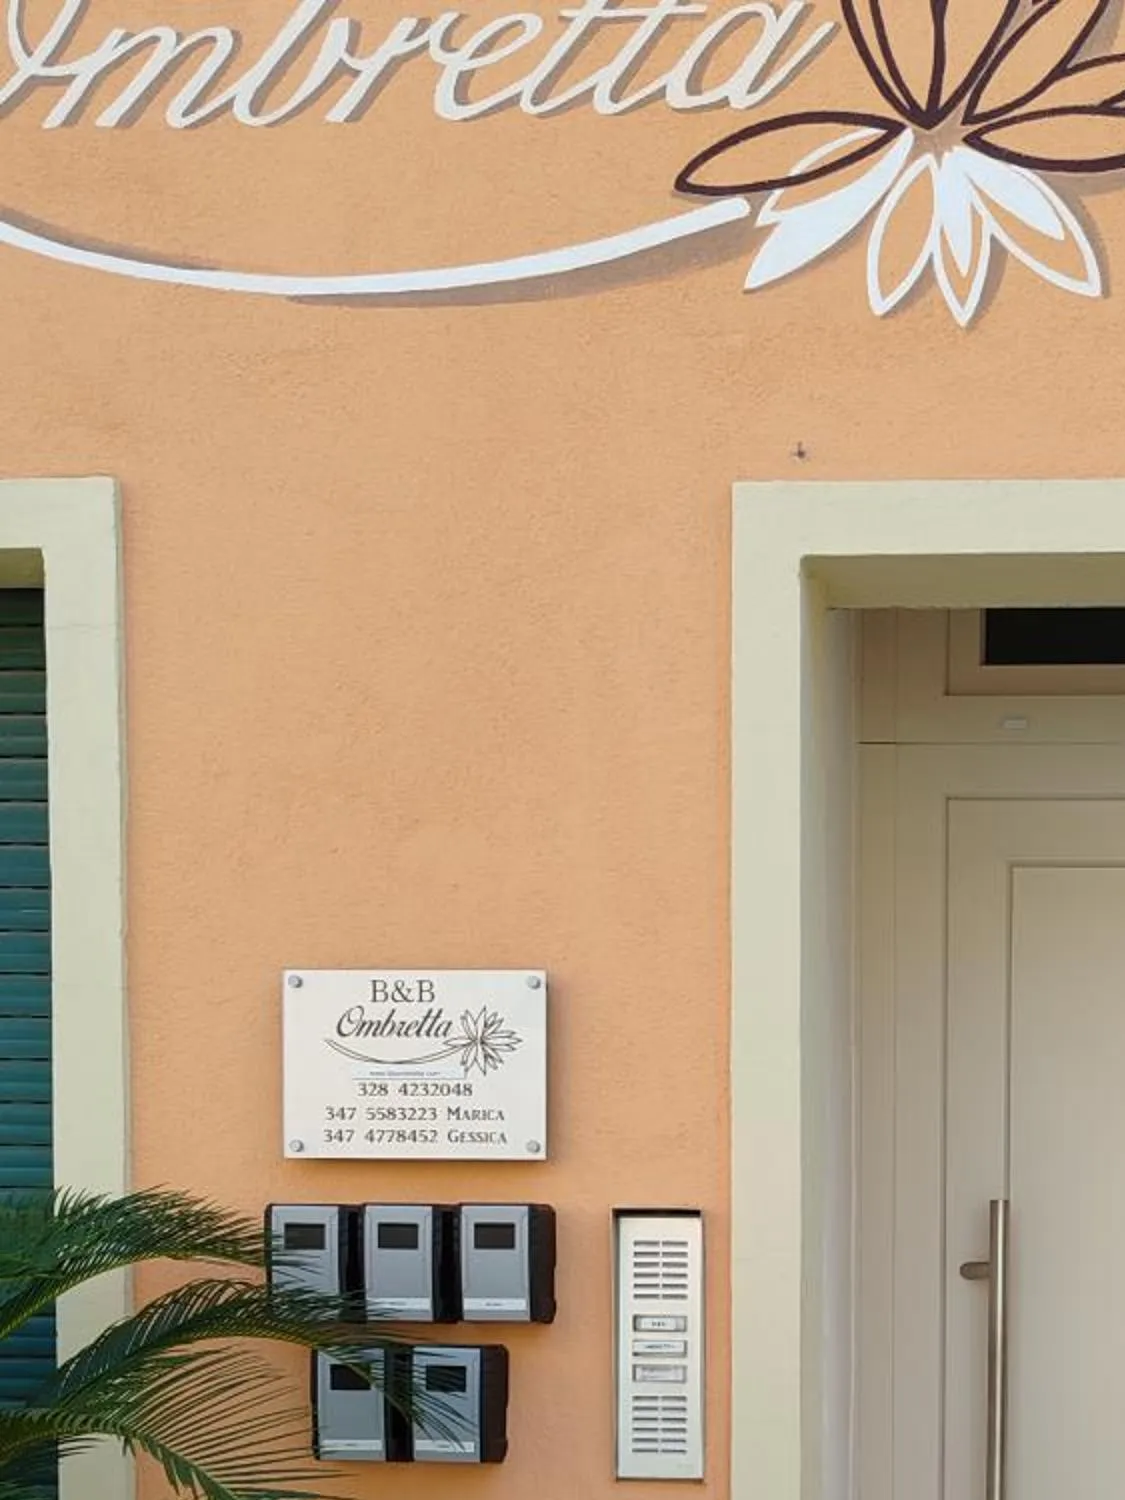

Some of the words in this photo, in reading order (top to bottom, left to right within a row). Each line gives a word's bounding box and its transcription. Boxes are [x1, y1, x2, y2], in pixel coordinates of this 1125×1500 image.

[371, 979, 435, 1003] B&B
[336, 1005, 453, 1038] Ombretta
[357, 1083, 388, 1097] 328
[398, 1082, 473, 1097] 4232048
[325, 1106, 357, 1121] 347
[365, 1107, 438, 1121] 5583223
[323, 1129, 355, 1143] 347
[364, 1128, 438, 1143] 4778452
